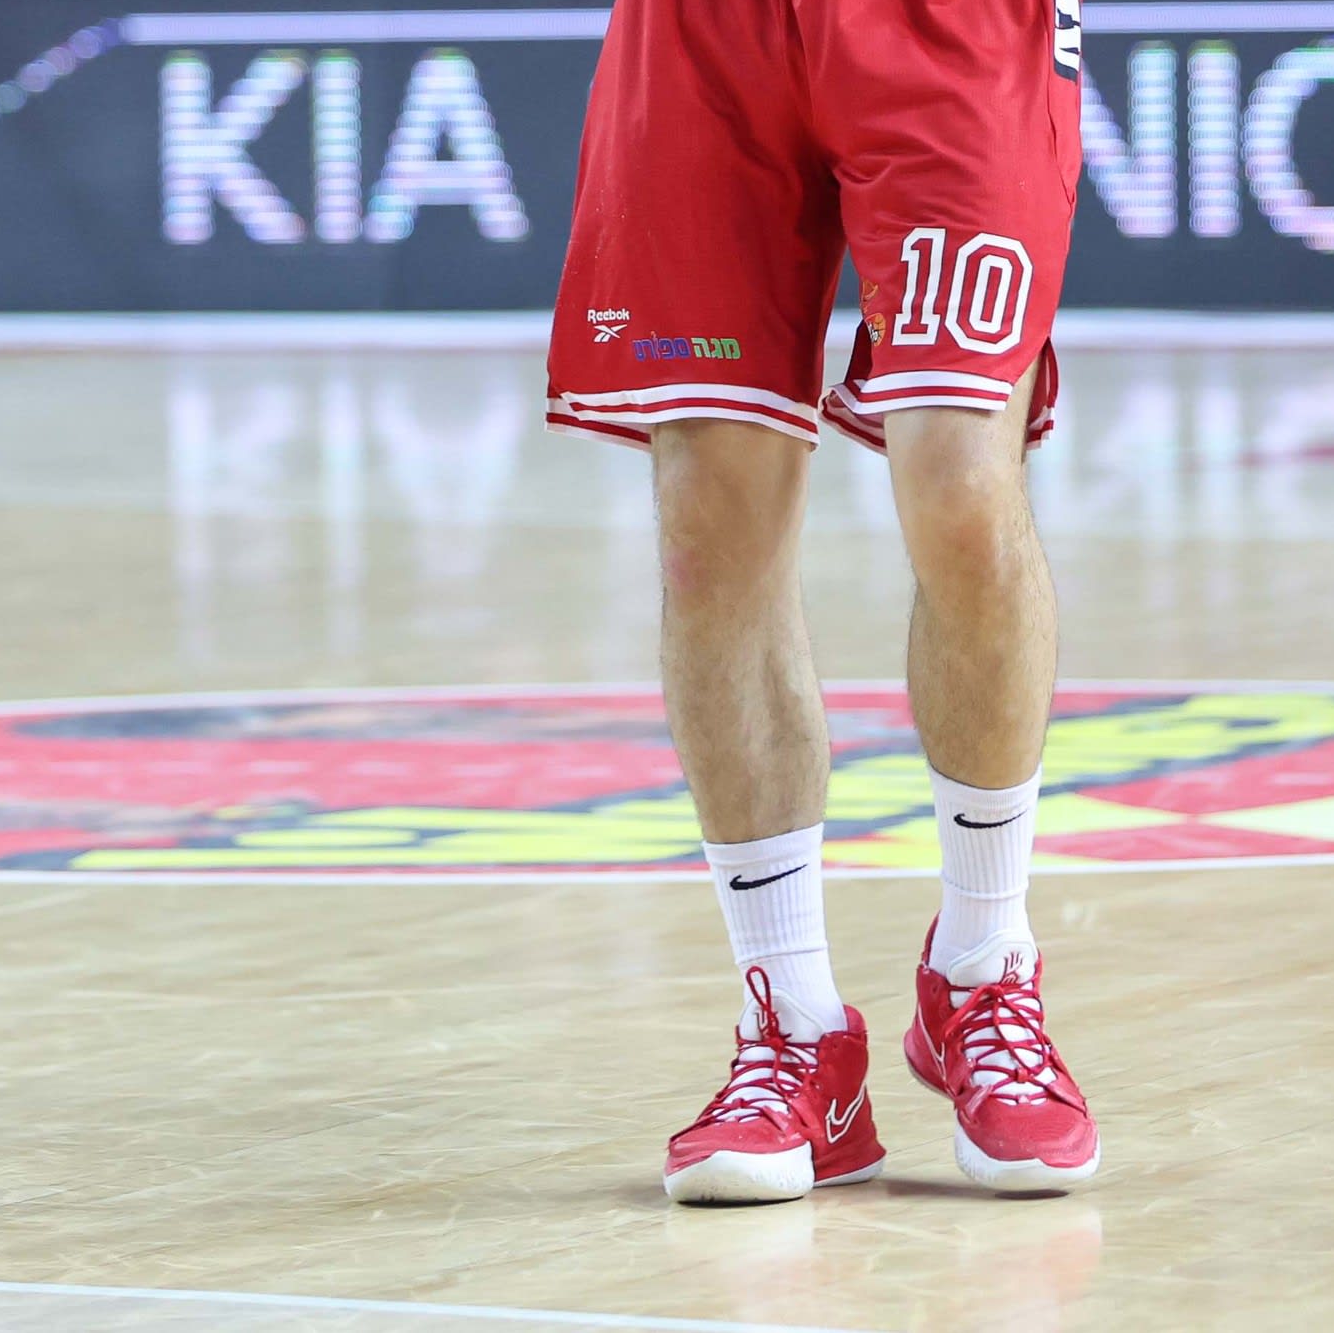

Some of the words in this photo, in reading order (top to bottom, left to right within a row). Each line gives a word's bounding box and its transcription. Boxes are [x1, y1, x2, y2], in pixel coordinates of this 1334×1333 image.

[158, 48, 531, 244] KIA
[587, 308, 631, 324] Reebok
[891, 227, 1034, 355] 10
[691, 337, 742, 359] מגה
